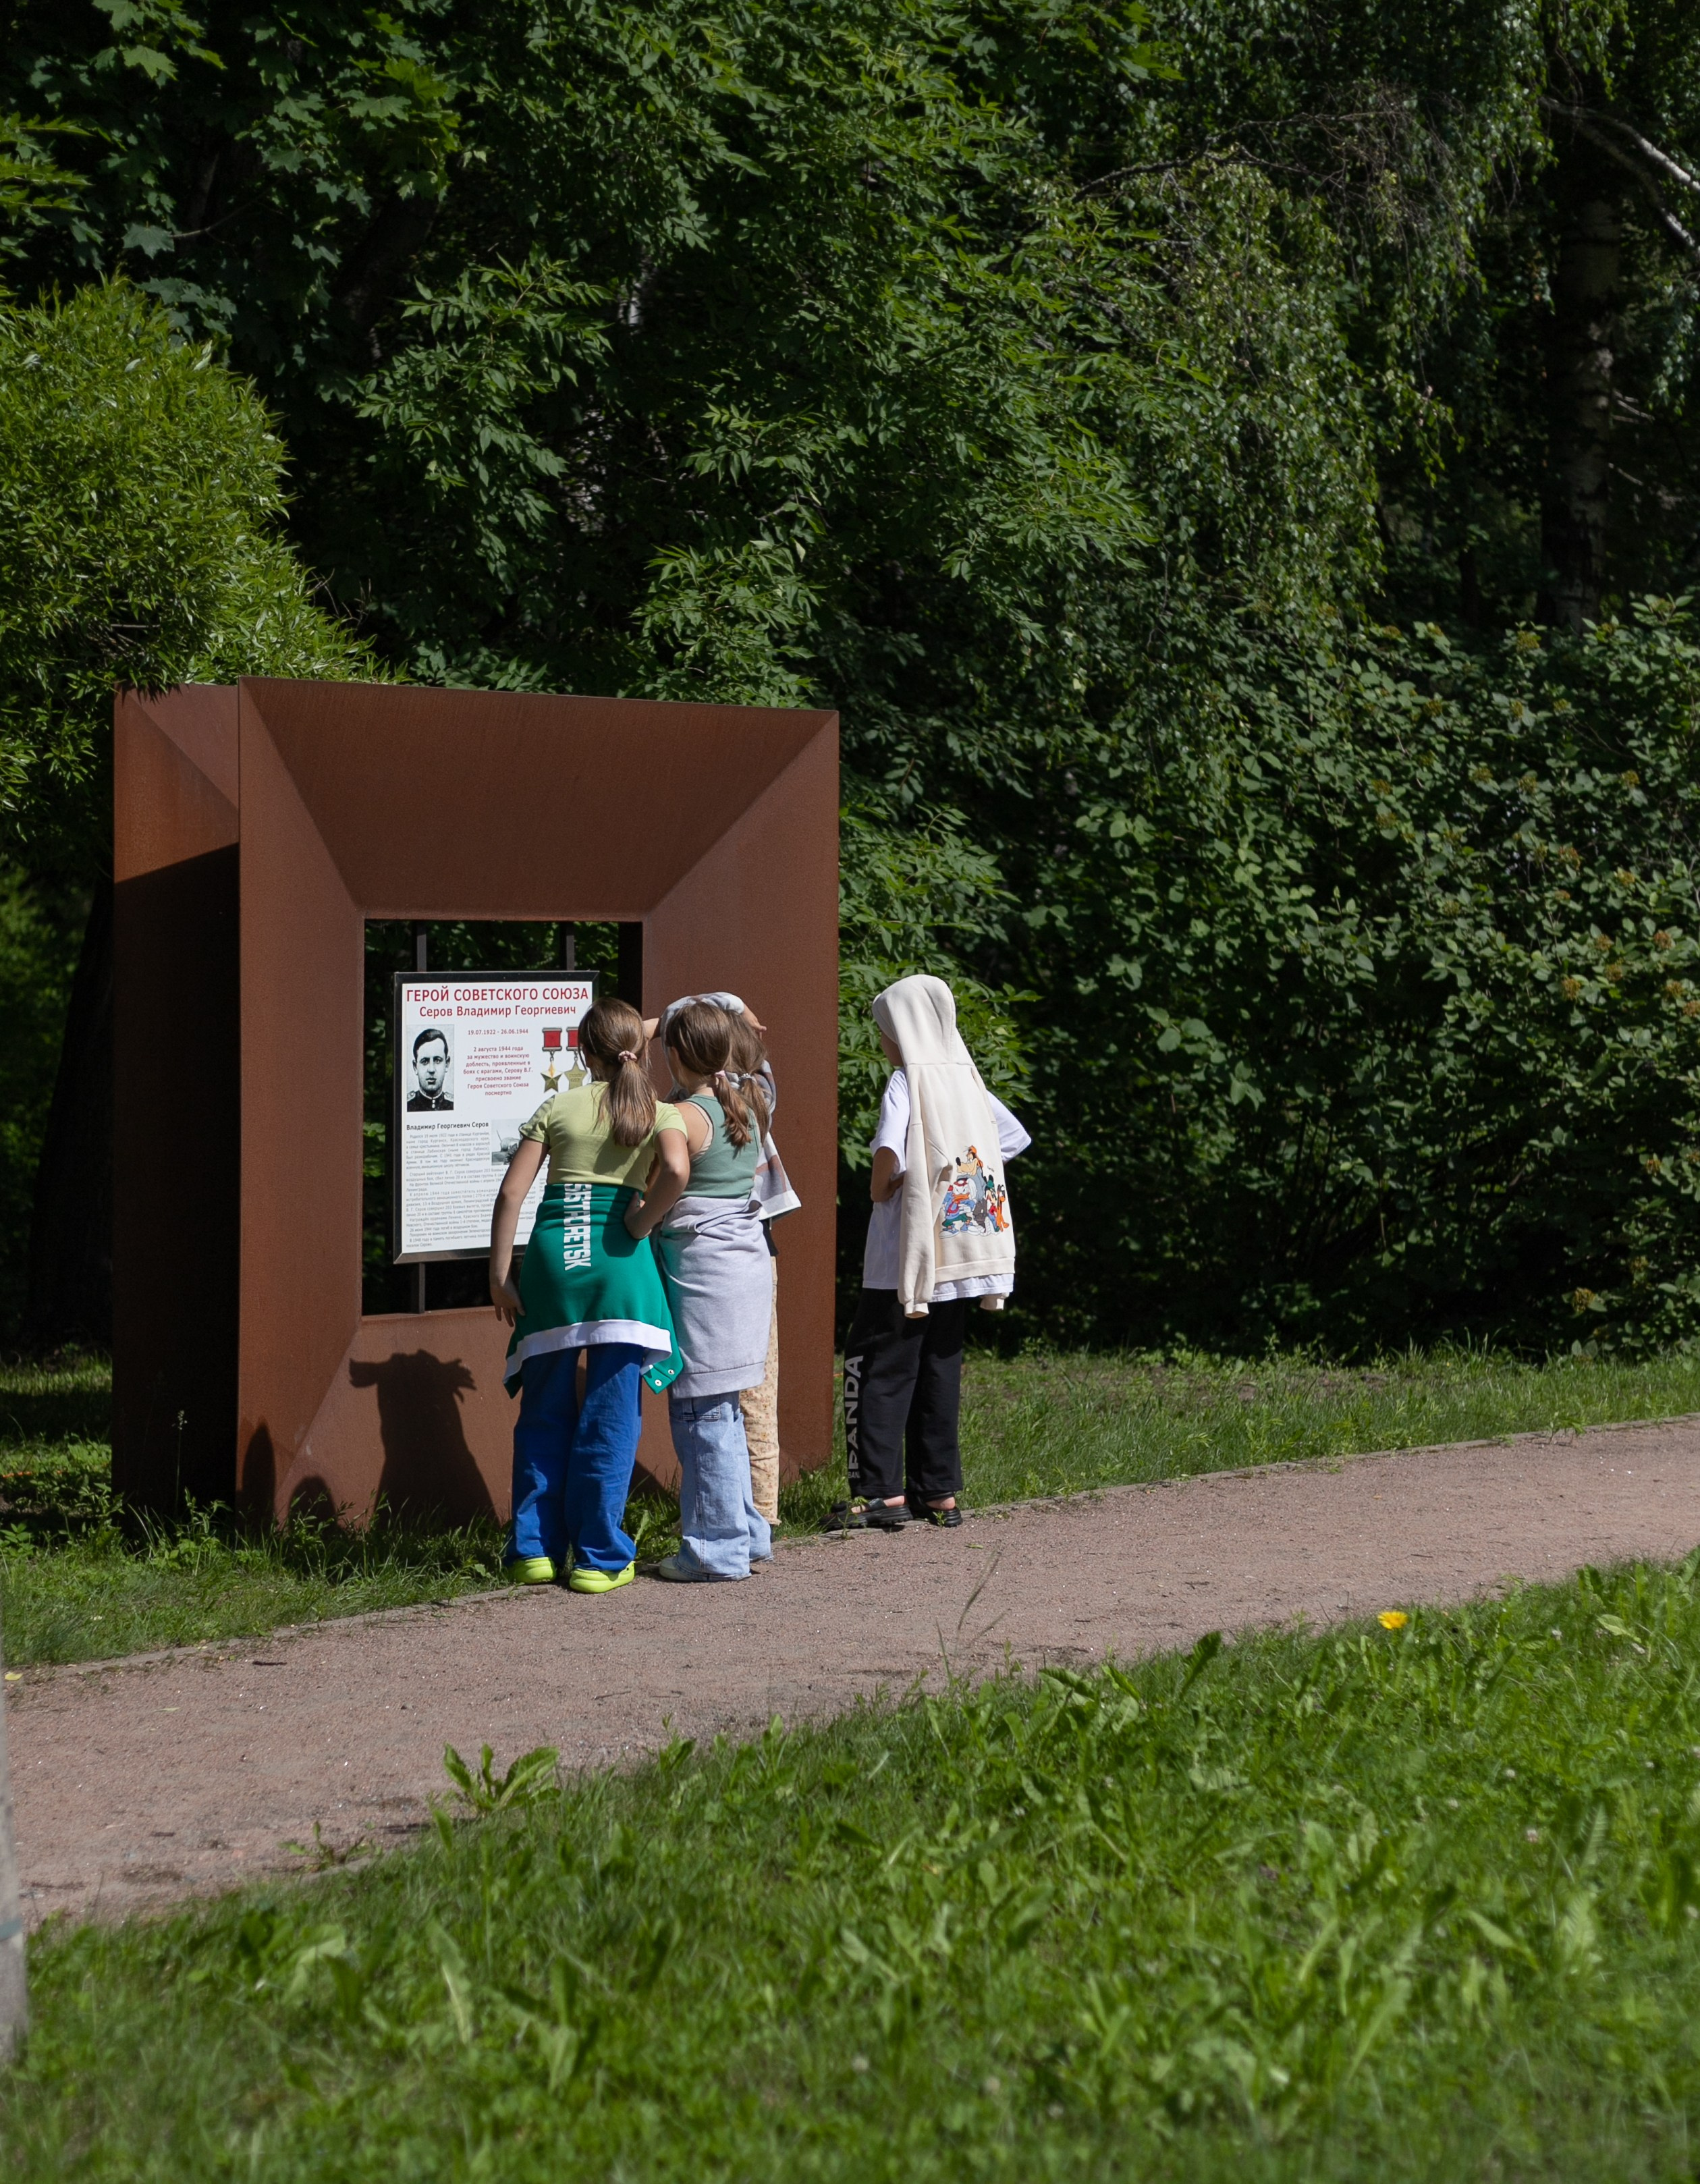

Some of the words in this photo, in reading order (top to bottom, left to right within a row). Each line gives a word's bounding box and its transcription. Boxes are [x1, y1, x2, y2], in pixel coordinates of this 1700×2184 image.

[407, 985, 449, 1002] ГЕРОЙ
[454, 988, 538, 1001] СОВЕТСКОГО
[543, 987, 588, 1000] СОЮЗА
[420, 1006, 452, 1019] Серов
[457, 1006, 511, 1018] Владимир
[515, 1004, 576, 1017] Георгиевич
[844, 1355, 864, 1469] PANDA
